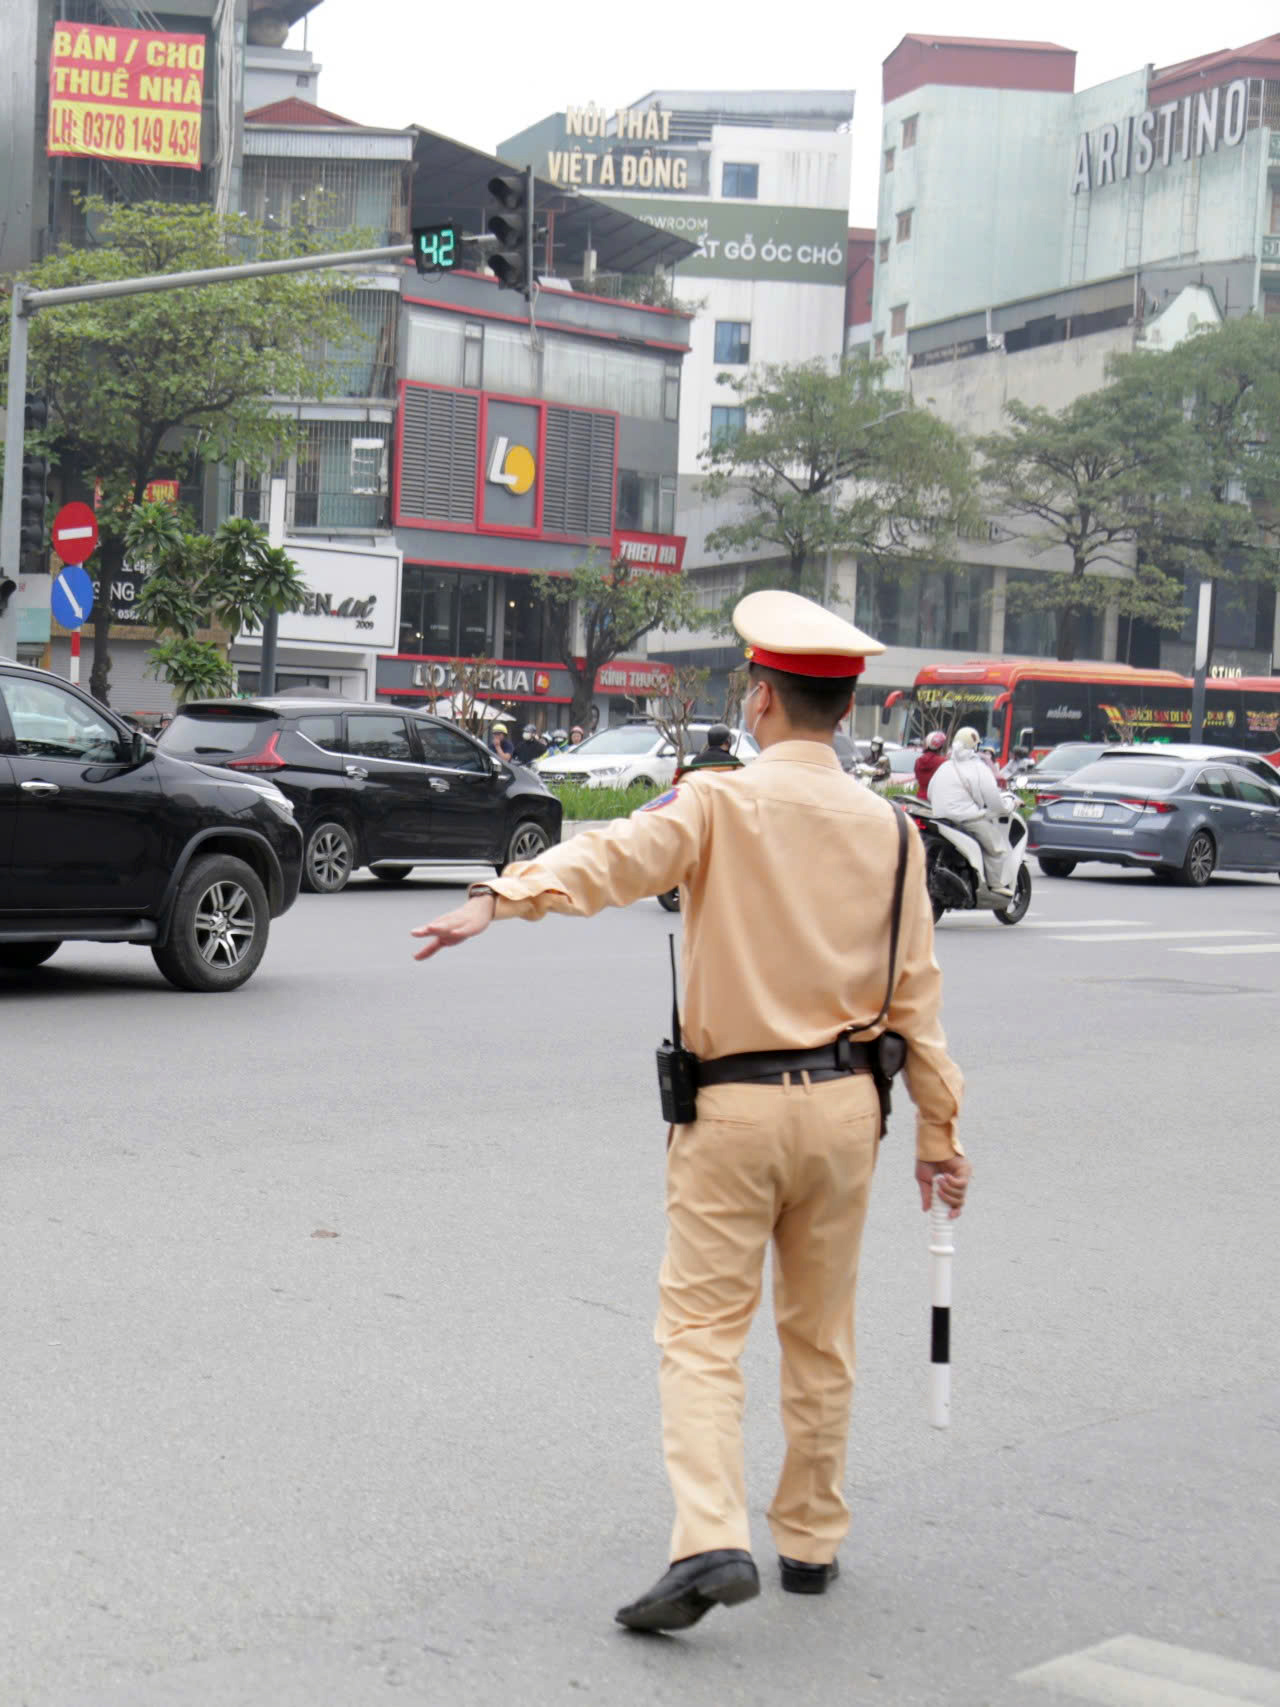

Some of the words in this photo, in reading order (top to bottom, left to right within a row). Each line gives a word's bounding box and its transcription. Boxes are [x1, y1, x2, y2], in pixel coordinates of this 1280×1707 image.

[53, 28, 117, 62] BÁN
[146, 40, 205, 70] CHO
[54, 66, 129, 99] THUÊ
[139, 73, 202, 106] NHÀ
[83, 111, 126, 151] 0378
[133, 115, 163, 154] 149
[169, 118, 198, 159] 434
[565, 100, 607, 143] NỘI
[616, 101, 672, 141] THẤT
[1072, 79, 1248, 195] ARISTINO
[548, 147, 596, 188] VIỆT
[622, 150, 688, 190] ĐÔNG
[634, 215, 709, 231] OWROOM
[421, 229, 454, 266] 42
[692, 234, 719, 259] ẤT
[724, 234, 754, 261] GỖ
[761, 240, 792, 262] ÓC
[796, 243, 843, 266] CHÓ
[92, 581, 135, 601] SNG
[356, 620, 375, 630] 2009
[1211, 665, 1242, 679] STINO
